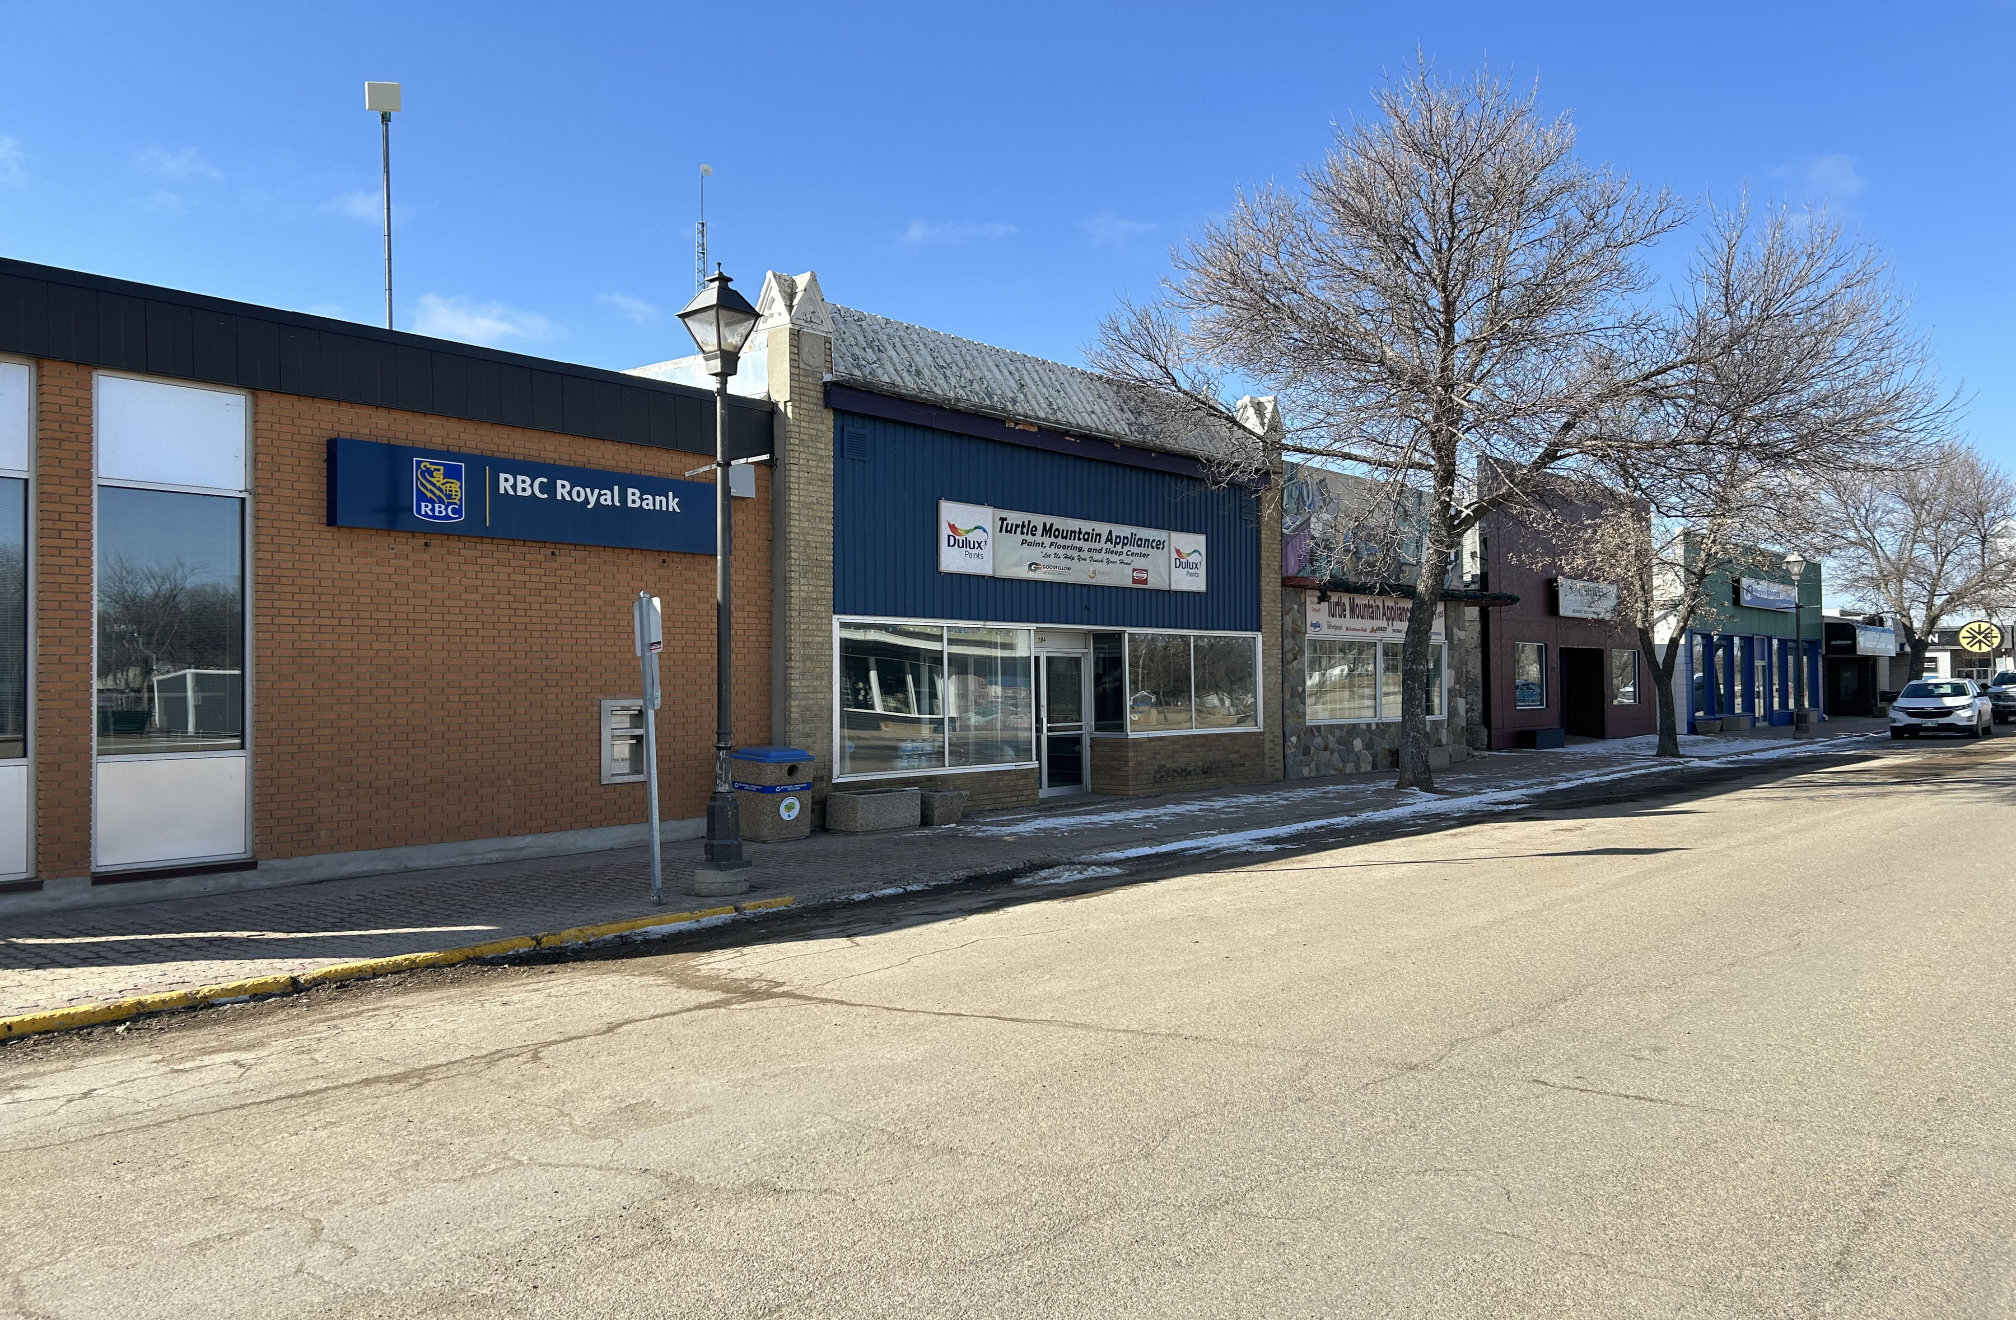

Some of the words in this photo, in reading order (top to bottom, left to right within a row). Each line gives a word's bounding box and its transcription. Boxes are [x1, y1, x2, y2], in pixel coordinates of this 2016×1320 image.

[498, 472, 549, 499] RBC
[556, 479, 621, 509] Royal
[626, 487, 681, 513] Bank
[420, 501, 460, 518] RBC
[947, 534, 983, 550] Dulux
[998, 516, 1038, 537] Turtle
[1040, 521, 1102, 544] Mountain
[1104, 529, 1166, 551] Appliances
[1020, 538, 1047, 549] Paint,
[1048, 541, 1085, 553] Flooring,
[1087, 546, 1104, 554] and
[1104, 547, 1124, 557] Sleep
[1125, 549, 1150, 559] Center
[1077, 554, 1087, 563] You
[1105, 557, 1118, 566] Your
[1174, 557, 1199, 570] Dulux
[1348, 596, 1381, 621] Mountain
